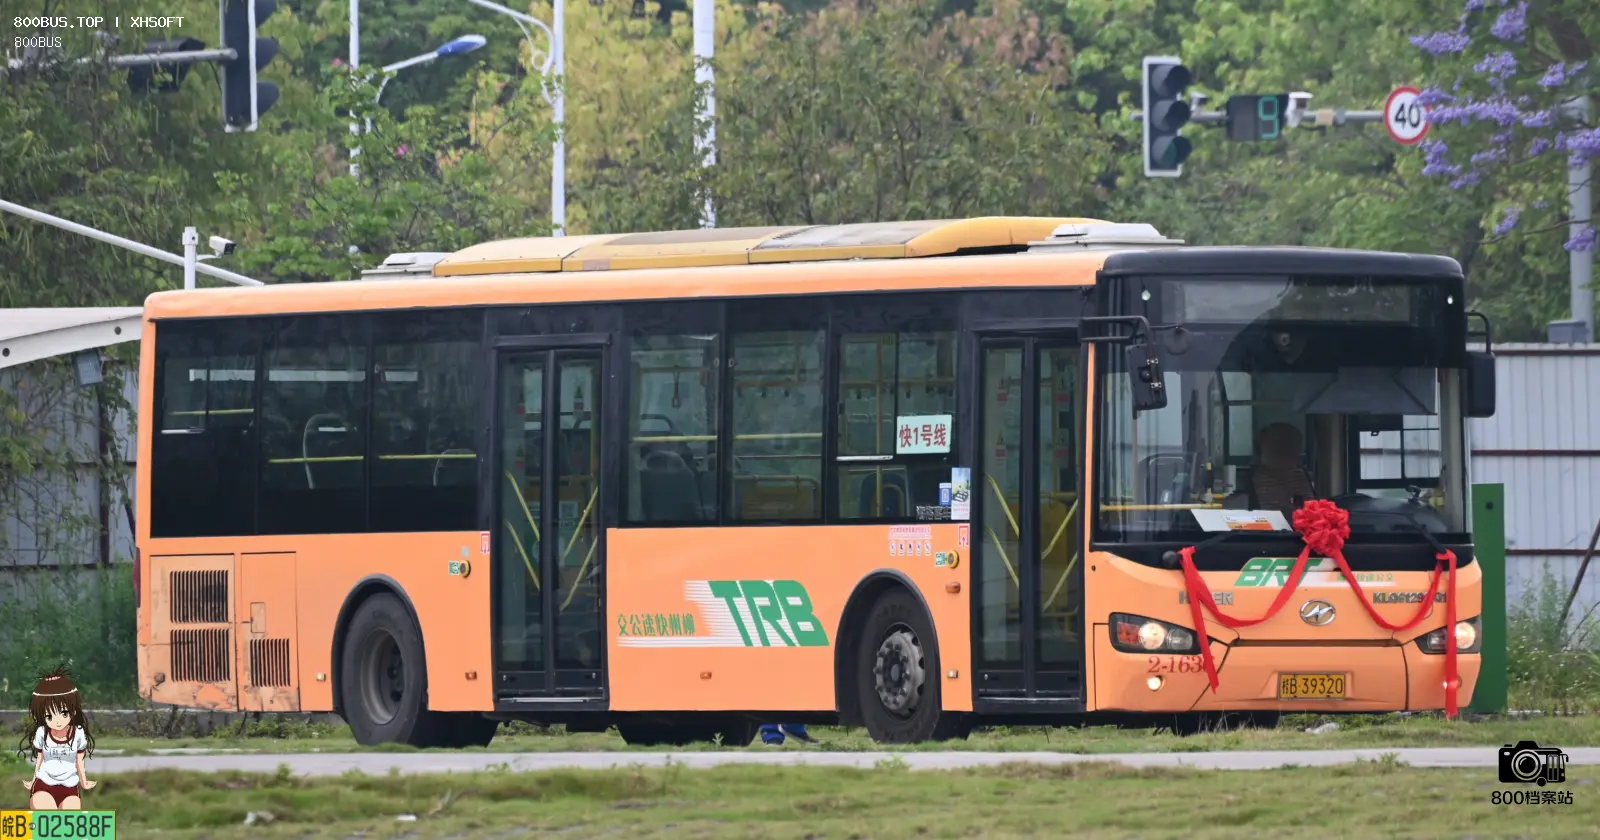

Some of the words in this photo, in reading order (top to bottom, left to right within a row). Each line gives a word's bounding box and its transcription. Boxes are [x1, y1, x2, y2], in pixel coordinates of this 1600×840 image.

[1258, 97, 1279, 139] 9
[1395, 103, 1421, 129] 40
[899, 424, 947, 447] 快1号线
[707, 579, 830, 647] TRB
[1147, 655, 1215, 674] 2-163
